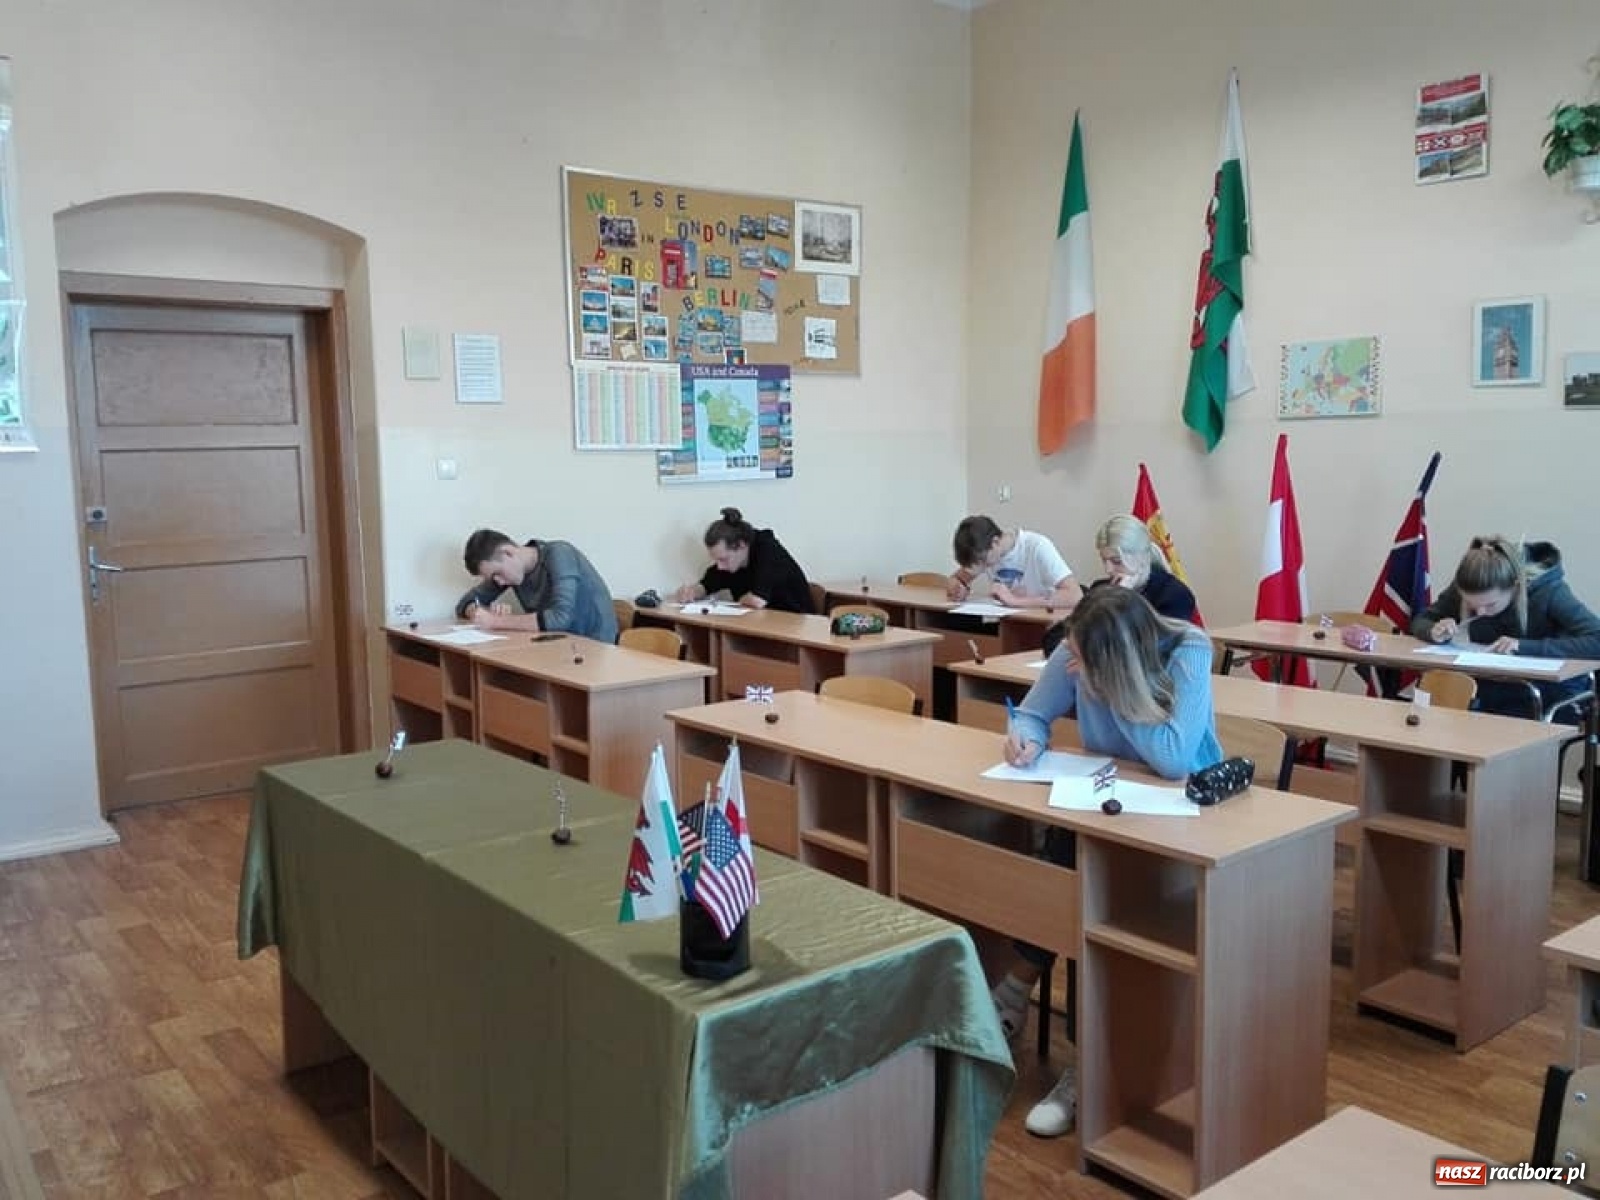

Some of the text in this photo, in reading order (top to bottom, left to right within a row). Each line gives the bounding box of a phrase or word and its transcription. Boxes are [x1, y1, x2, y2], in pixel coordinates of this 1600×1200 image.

[665, 216, 740, 245] LONDON
[595, 246, 656, 281] PARIS
[682, 287, 750, 311] BERLIN
